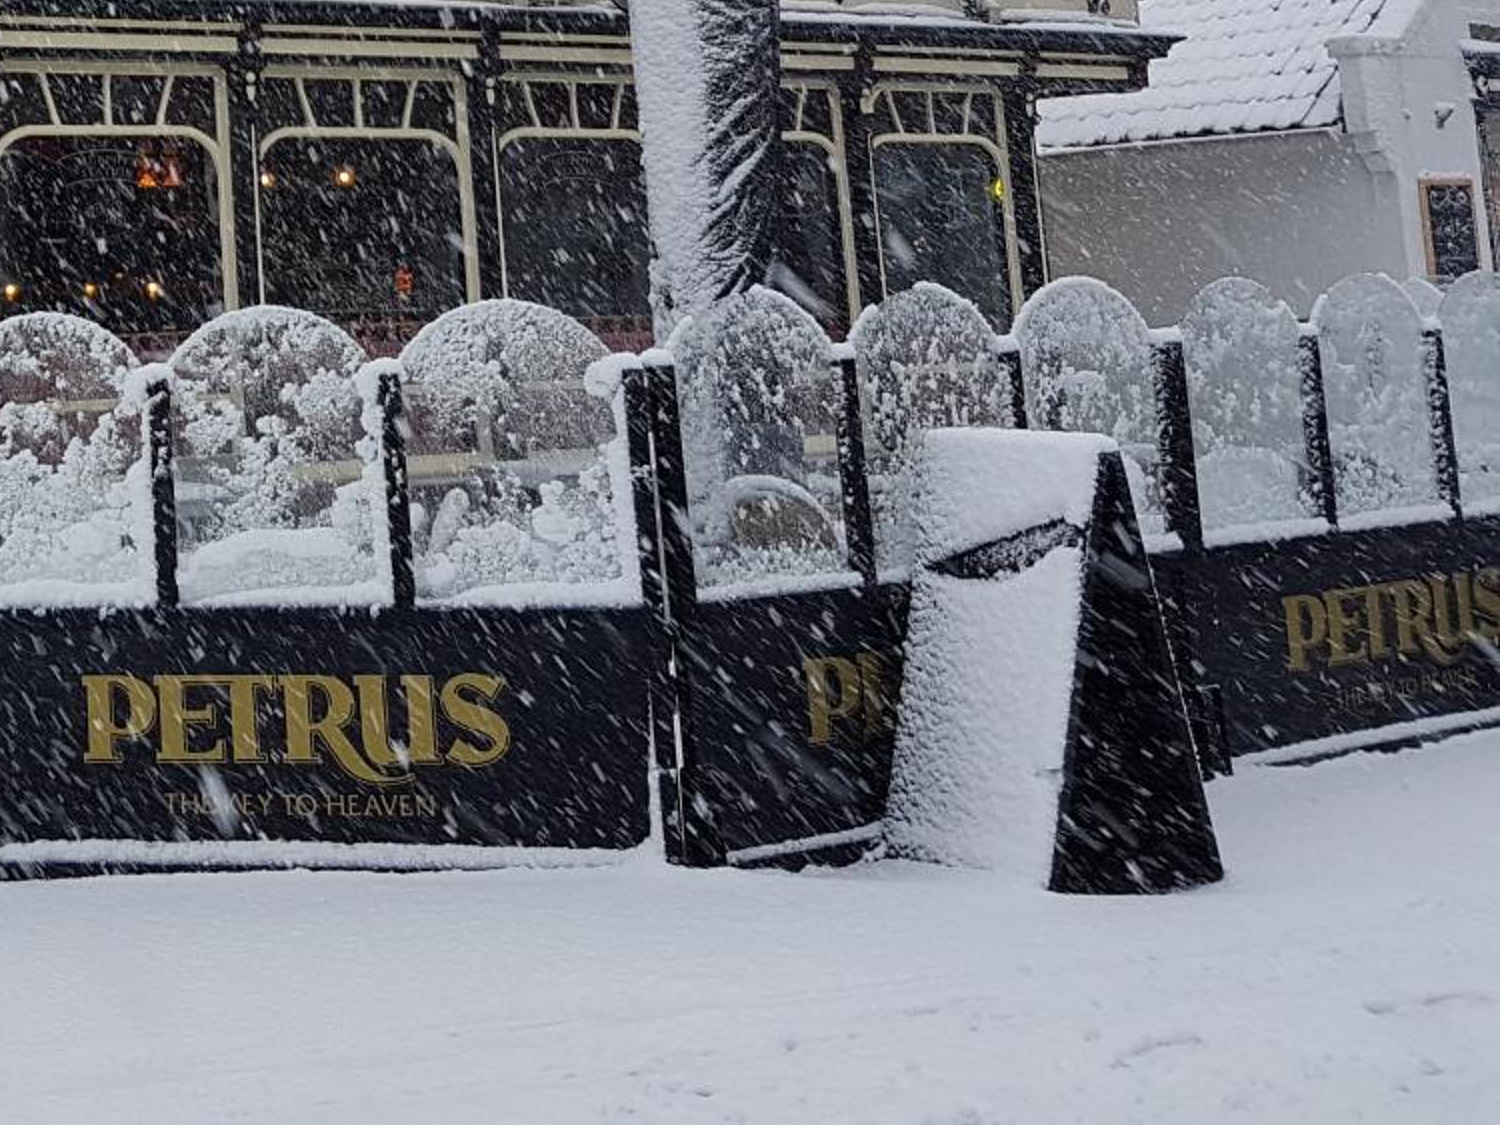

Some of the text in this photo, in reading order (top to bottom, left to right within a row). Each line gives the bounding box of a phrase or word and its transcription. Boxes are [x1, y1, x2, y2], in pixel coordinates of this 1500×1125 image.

[1282, 567, 1500, 674] PETRUS
[82, 672, 511, 784] PETRUS
[165, 793, 215, 815] TH
[285, 794, 317, 816] TO
[327, 794, 436, 817] HEAVEN
